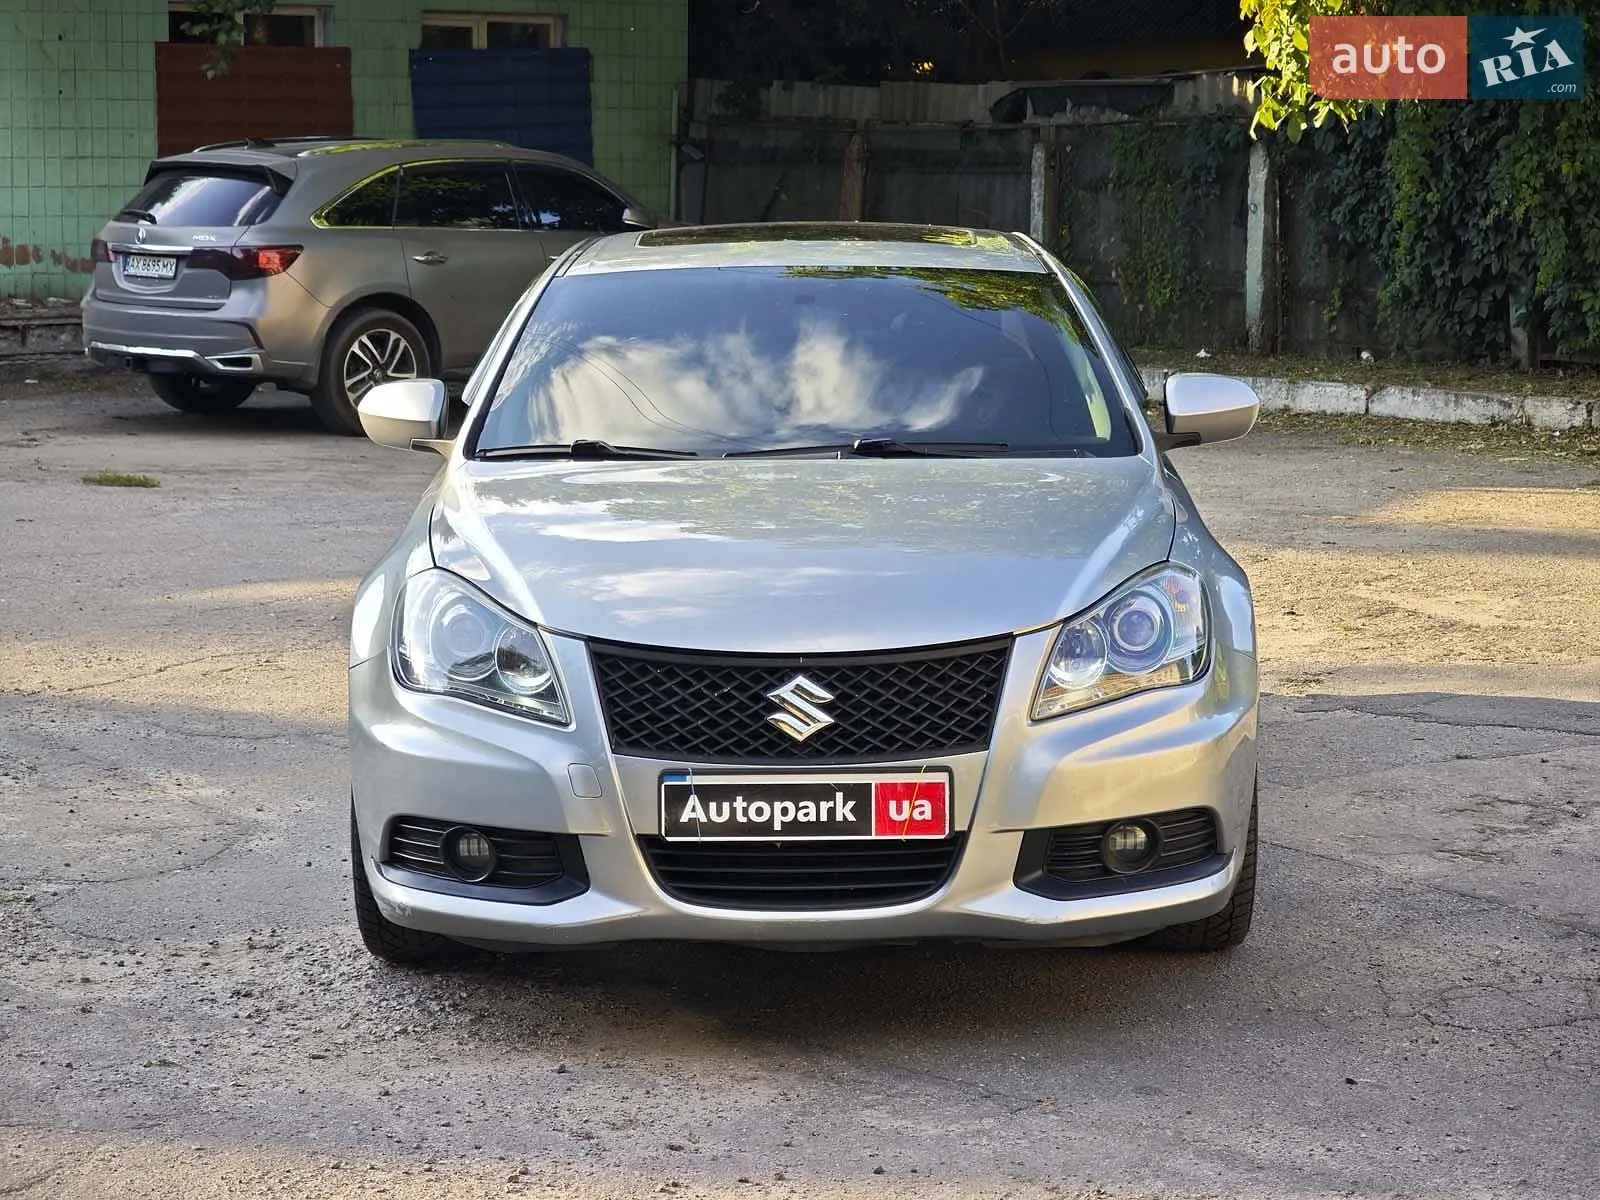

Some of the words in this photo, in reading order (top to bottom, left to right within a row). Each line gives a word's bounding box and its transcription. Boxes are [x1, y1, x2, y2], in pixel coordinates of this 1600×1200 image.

[130, 256, 141, 271] AX
[141, 257, 161, 272] 8695
[162, 259, 176, 273] MX
[679, 791, 857, 831] Autopark
[888, 799, 932, 821] ua
